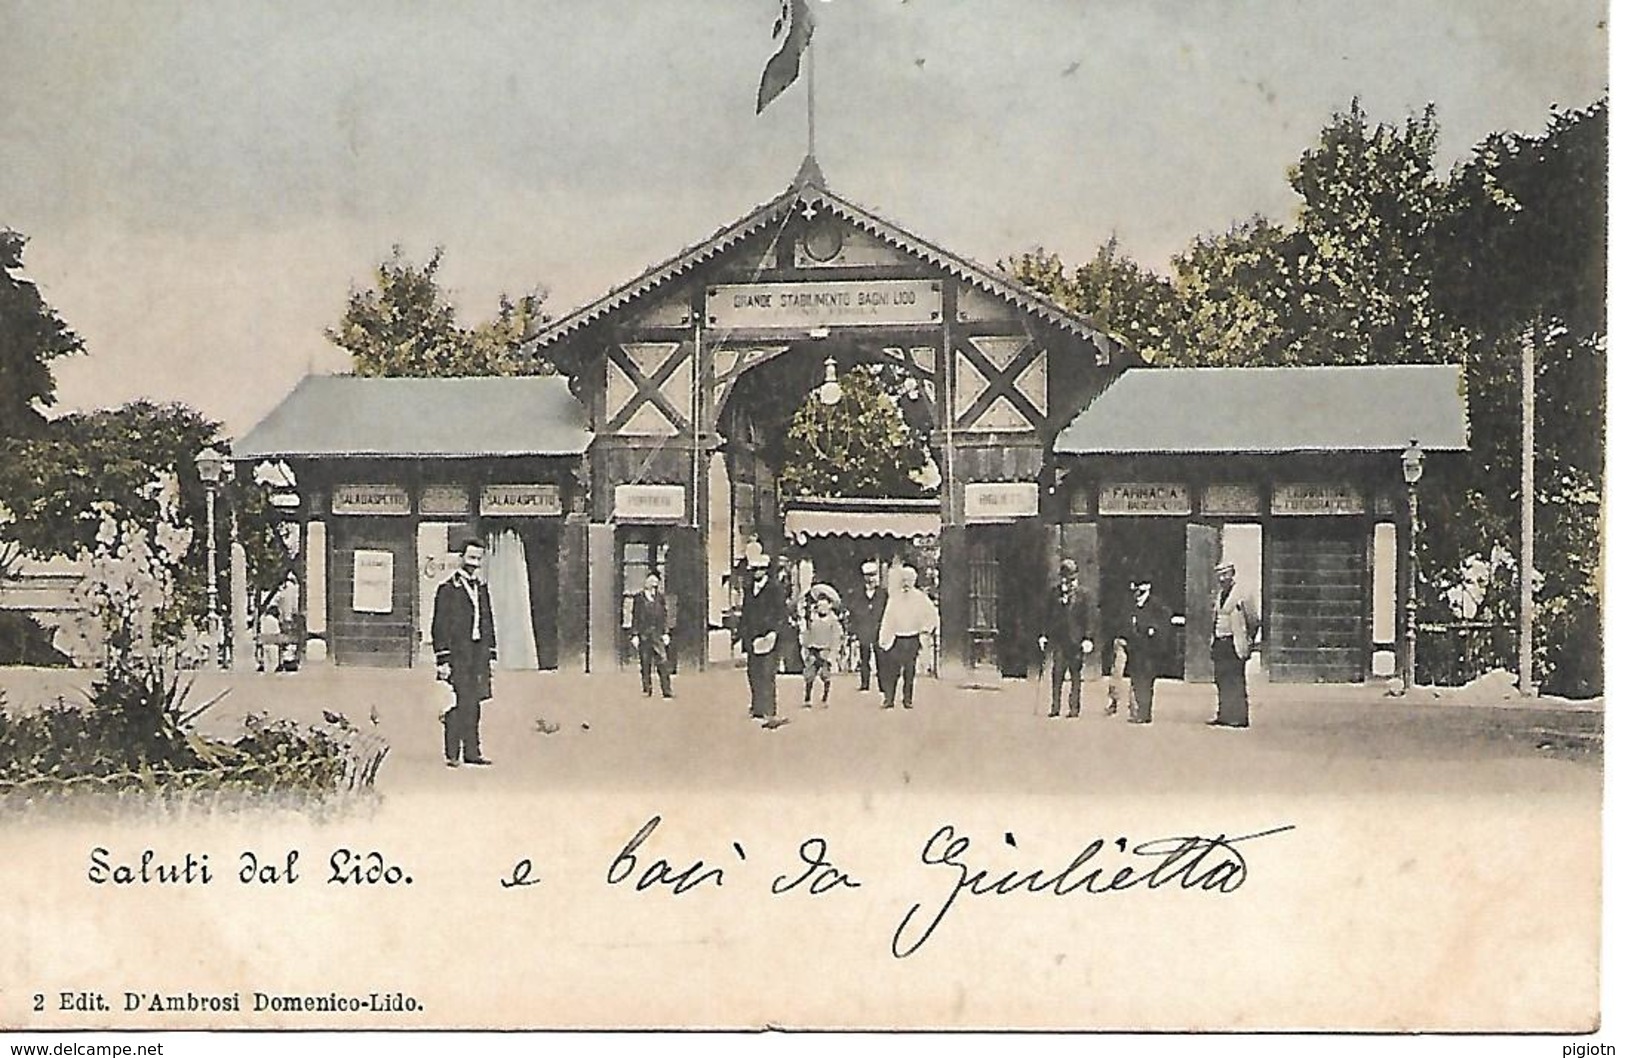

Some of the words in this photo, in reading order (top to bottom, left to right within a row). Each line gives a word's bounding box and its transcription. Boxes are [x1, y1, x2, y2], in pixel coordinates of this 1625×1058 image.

[733, 294, 772, 309] GRANDE
[780, 292, 850, 308] STABILIMENTO
[857, 291, 889, 306] BAGNI
[893, 291, 916, 305] LIDO
[88, 847, 213, 884] Saluti
[239, 850, 299, 884] dal
[327, 848, 413, 885] Lido.
[501, 859, 541, 888] e
[772, 839, 861, 895] da
[893, 826, 1295, 958] Giulietta
[33, 993, 44, 1012] 2
[58, 992, 110, 1012] Edit.
[123, 992, 240, 1012] D'Ambrosi
[253, 992, 424, 1012] Domenico-Lido.
